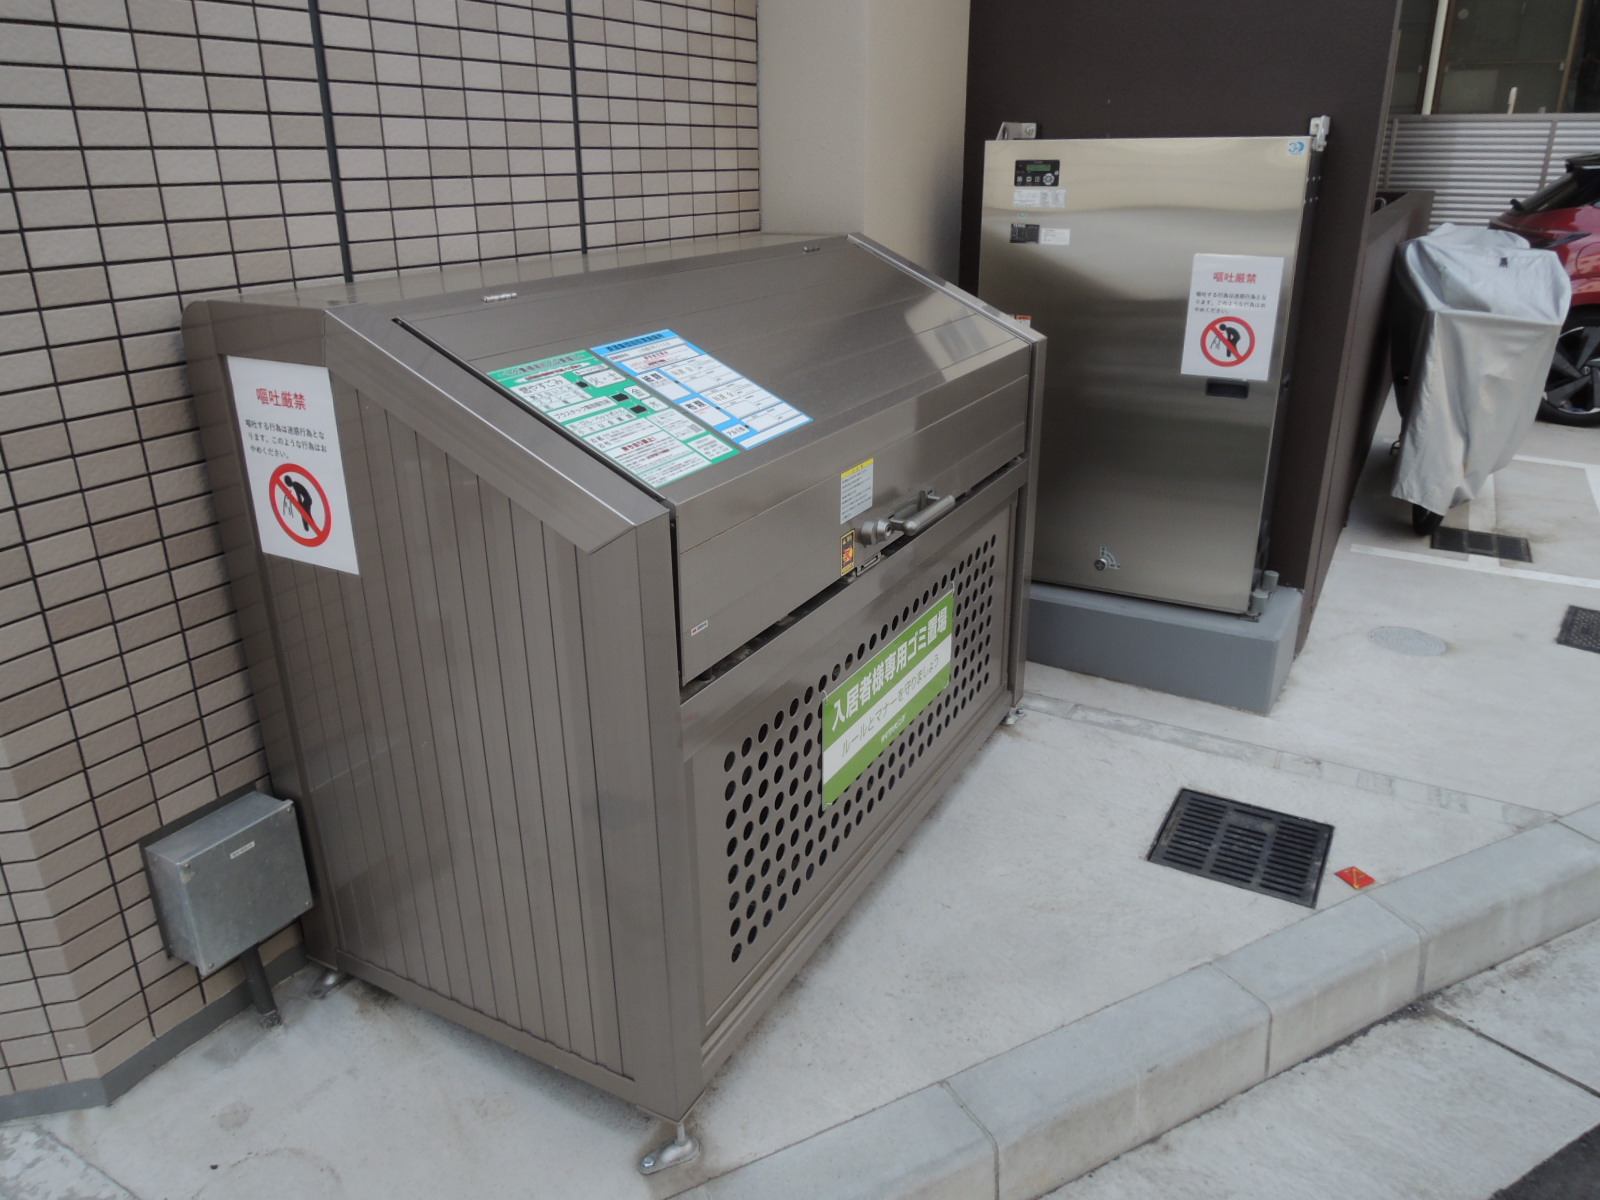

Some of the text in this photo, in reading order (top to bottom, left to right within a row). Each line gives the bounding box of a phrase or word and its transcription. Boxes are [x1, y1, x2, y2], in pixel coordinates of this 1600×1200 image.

[1213, 272, 1257, 283] 嘔吐厳禁
[255, 388, 307, 410] 嘔吐厳禁
[631, 388, 643, 396] 金
[245, 419, 325, 440] 嘔吐する行為は迷惑行為とな
[248, 433, 327, 453] ります。このような行為はお
[249, 445, 290, 459] やめください。
[832, 606, 948, 732] 入居者様専用ゴミ置場
[841, 654, 939, 758] ルールとマナーを守りましょう
